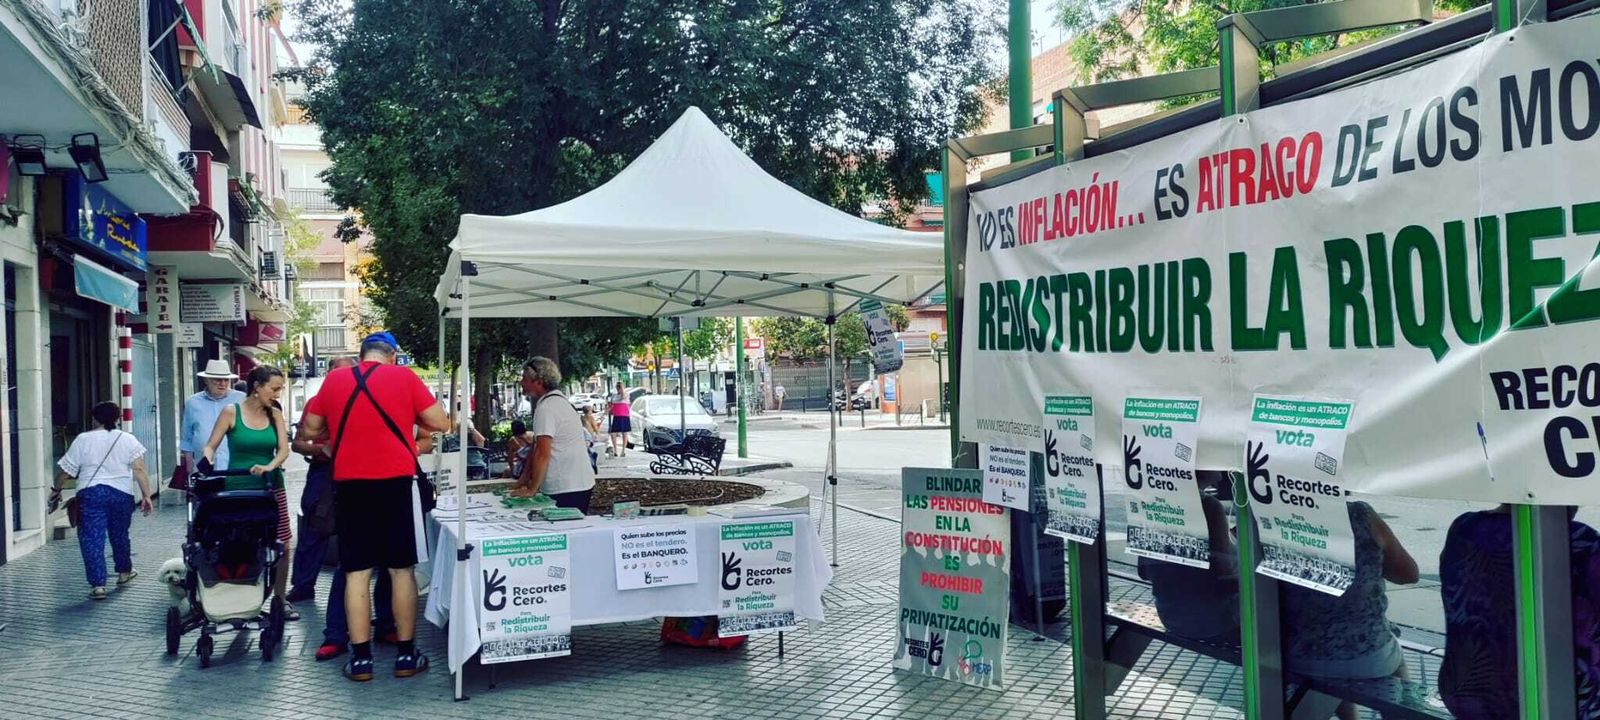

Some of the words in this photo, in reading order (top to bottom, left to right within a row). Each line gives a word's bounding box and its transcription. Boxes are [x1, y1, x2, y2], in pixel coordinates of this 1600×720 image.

[1000, 206, 1015, 248] ES
[1154, 163, 1189, 221] ES
[1196, 132, 1322, 213] ATRACO
[1331, 115, 1388, 188] DE
[1392, 86, 1481, 174] LOS
[1500, 59, 1600, 152] MO
[154, 268, 169, 320] GARAJE
[978, 257, 1215, 353] REDISTRIBUIR
[1229, 246, 1307, 352] LA
[1489, 362, 1600, 410] RECO
[1266, 401, 1296, 411] inflación
[1317, 406, 1348, 415] ATRACO
[1056, 418, 1078, 431] vota
[1269, 413, 1294, 422] bancos
[976, 418, 1041, 438] www.recortescero.es
[1143, 423, 1172, 438] vota
[1276, 429, 1315, 448] vota
[1544, 416, 1600, 478] C
[1061, 453, 1094, 467] Recortes
[1146, 463, 1193, 480] Recortes
[926, 476, 982, 493] BLINDAR
[1277, 474, 1340, 497] Recortes
[906, 494, 928, 509] LAS
[1065, 498, 1086, 509] Riqueza
[1280, 490, 1319, 509] Cero.
[1141, 501, 1185, 516] Redistribuir
[1146, 512, 1153, 520] la
[935, 516, 952, 530] EN
[955, 516, 971, 532] LA
[1154, 513, 1185, 526] Riqueza
[1274, 517, 1328, 537] Redistribuir
[665, 529, 687, 537] precios
[1281, 528, 1289, 540] la
[1291, 530, 1327, 550] Riqueza
[742, 540, 773, 551] vota
[905, 530, 1003, 556] CONSTITUCIÓN
[641, 548, 688, 558] BANQUERO.
[508, 554, 544, 568] vota
[944, 555, 960, 571] ES
[746, 567, 792, 577] Recortes
[746, 577, 775, 586] Cero.
[922, 572, 984, 594] PROHIBIR
[513, 584, 566, 596] Recortes
[736, 594, 776, 603] Redistribuir
[746, 602, 774, 610] Riqueza
[942, 594, 959, 611] SU
[501, 614, 550, 626] Redistribuir
[901, 607, 1001, 639] PRIVATIZACIÓN
[514, 624, 547, 634] Riqueza
[904, 638, 930, 649] RECORTES
[908, 645, 927, 659] CERO
